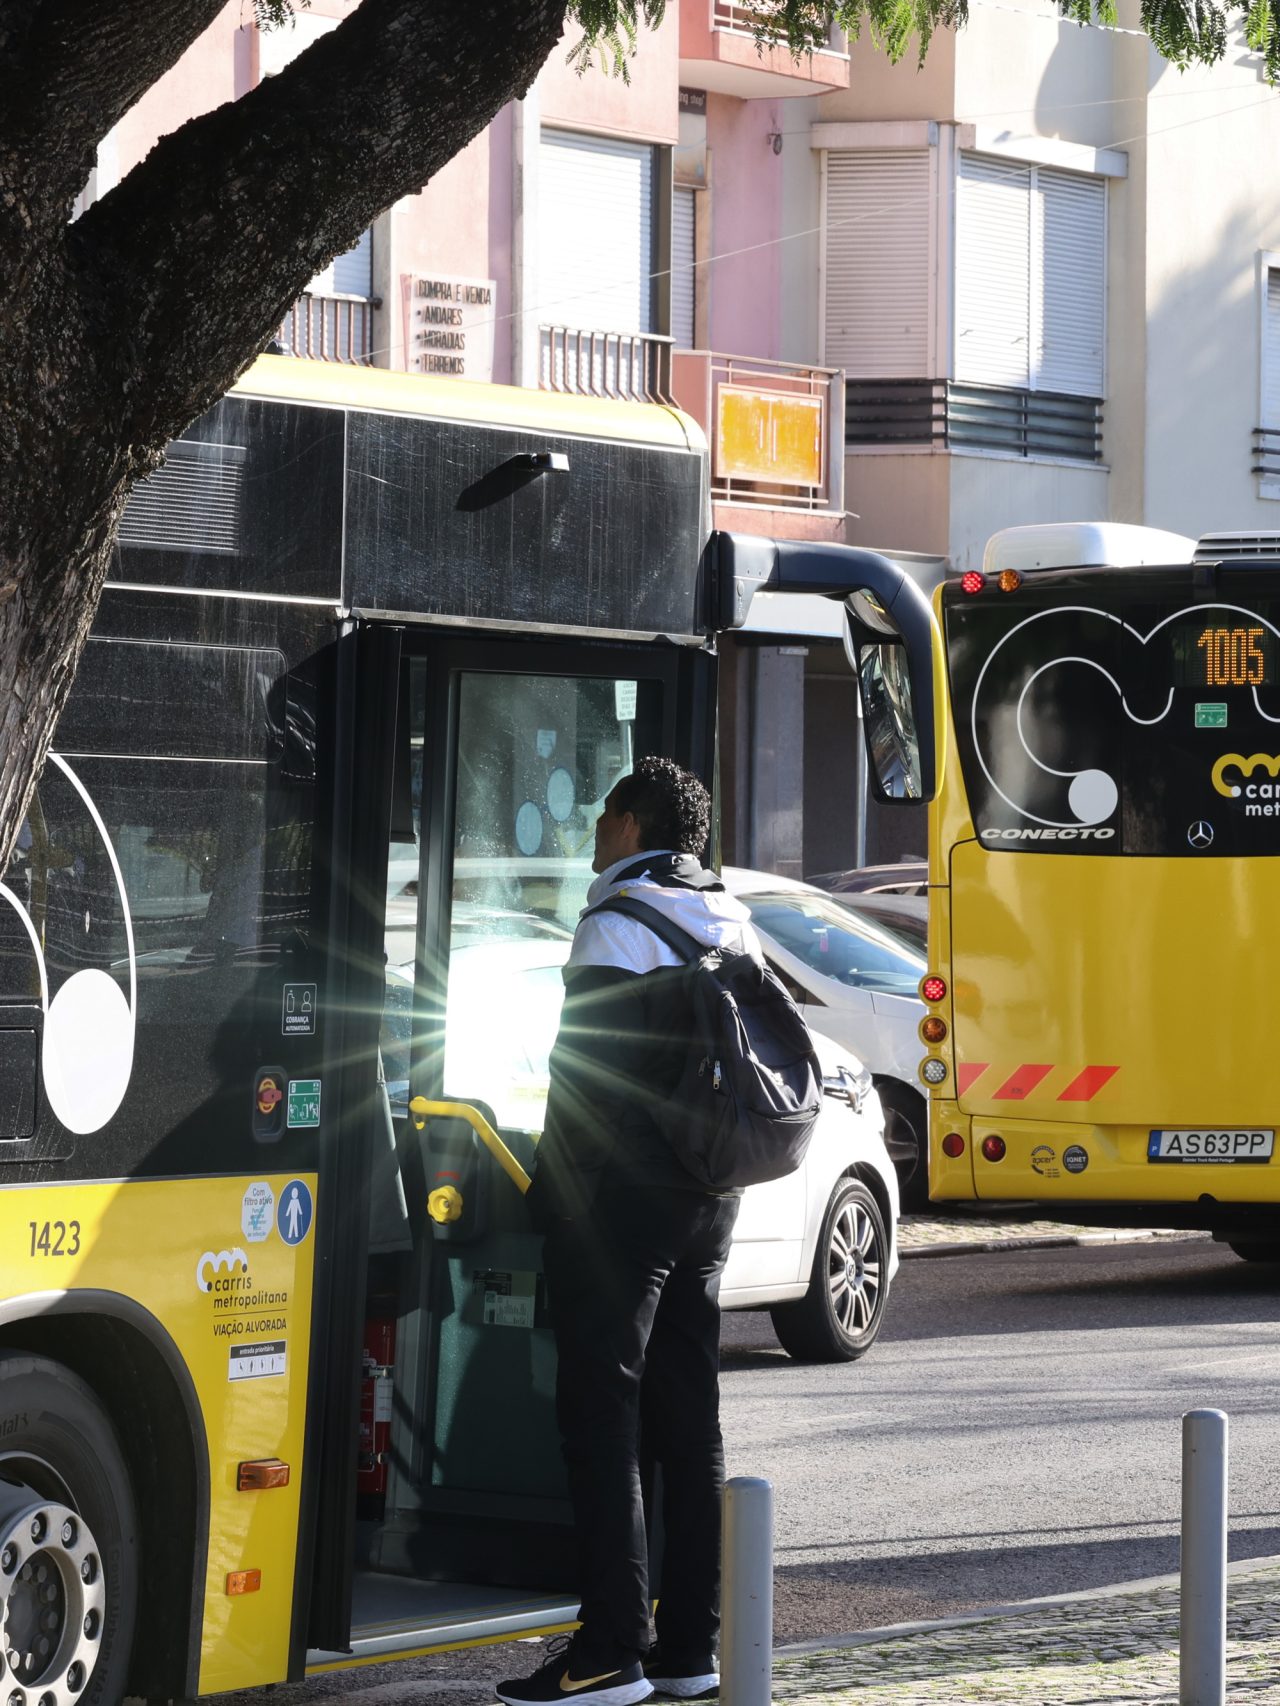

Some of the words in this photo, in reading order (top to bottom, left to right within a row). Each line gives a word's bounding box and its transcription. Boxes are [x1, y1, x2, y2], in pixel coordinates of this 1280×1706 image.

[417, 279, 452, 300] COMPRA
[456, 284, 462, 301] E
[465, 285, 491, 305] VENDA
[424, 305, 463, 325] ANDARES
[424, 329, 466, 350] MORADIAS
[423, 353, 465, 374] TERRENOS
[1196, 627, 1264, 686] 1005
[980, 827, 1116, 840] CONECTO
[286, 1015, 309, 1024] COBRANÇA
[1166, 1133, 1265, 1155] AS63PP
[244, 1197, 258, 1206] filtro
[258, 1196, 273, 1206] ativo
[252, 1187, 265, 1197] Com
[29, 1219, 82, 1257] 1423
[214, 1277, 252, 1292] carris
[213, 1290, 288, 1309] metropolitana
[213, 1319, 243, 1338] VIAÇÃO
[245, 1318, 287, 1333] ALVORADA
[239, 1346, 255, 1355] entrada
[254, 1345, 275, 1355] prioritária
